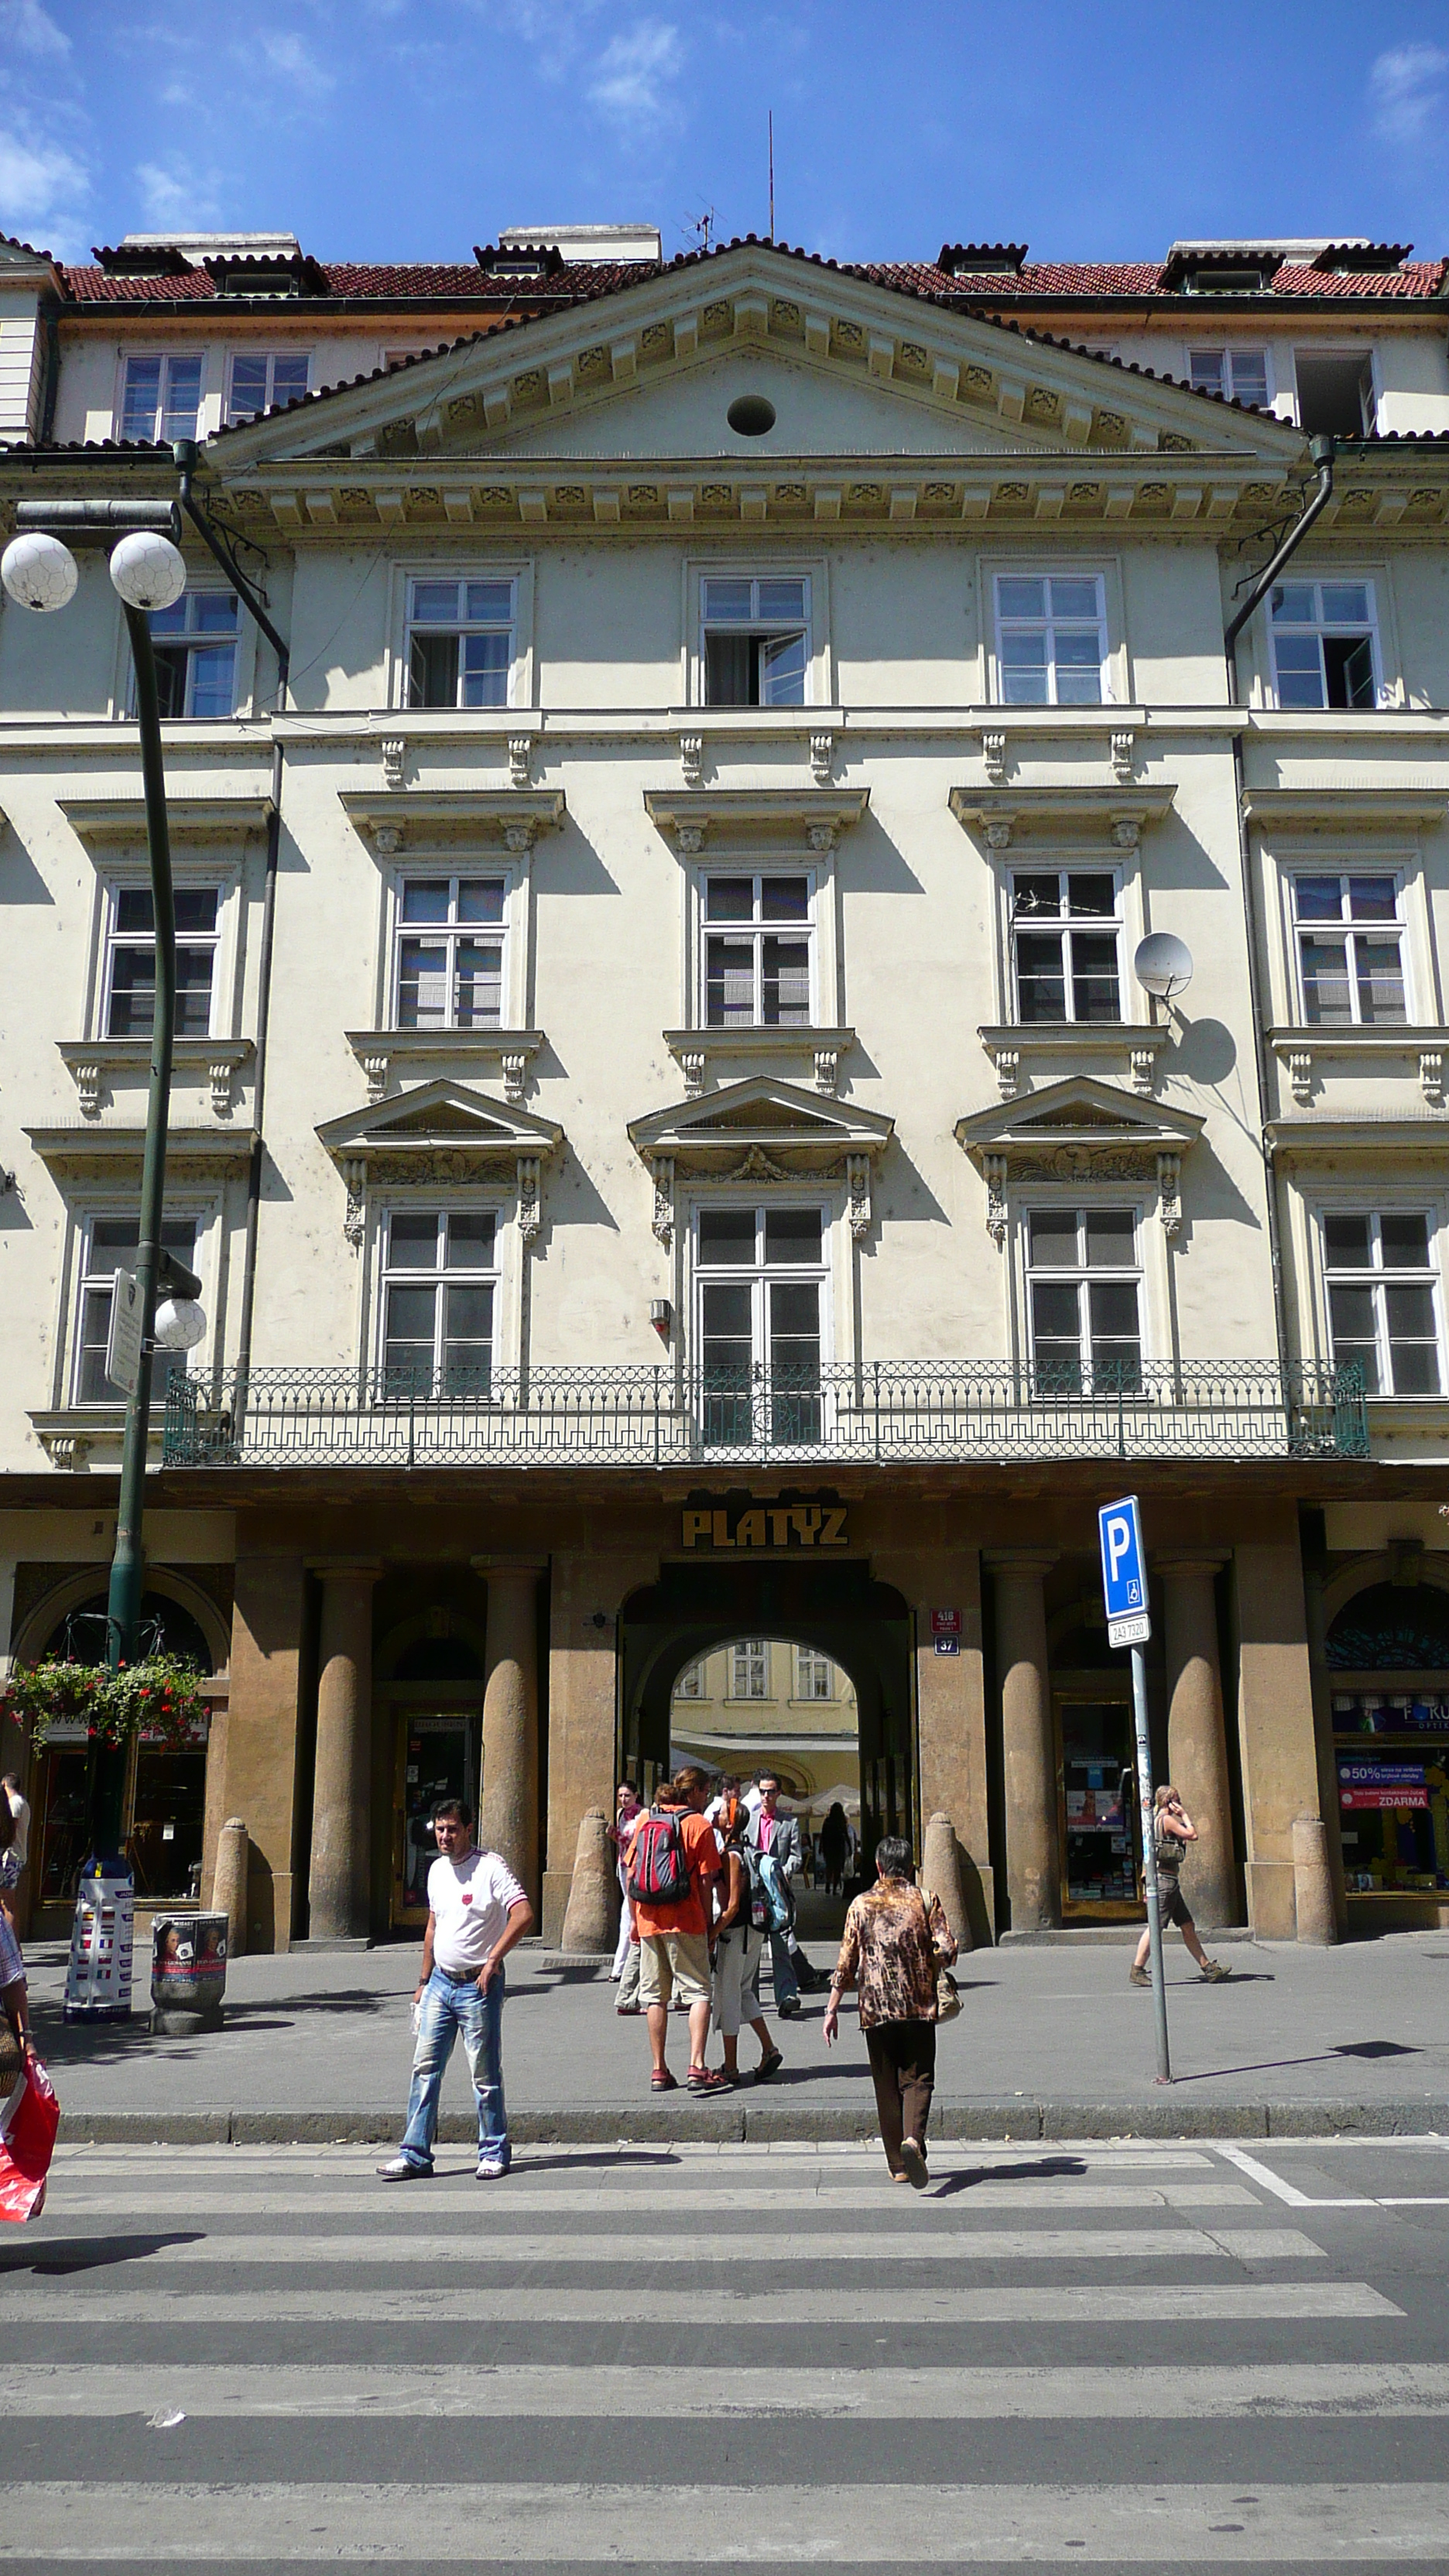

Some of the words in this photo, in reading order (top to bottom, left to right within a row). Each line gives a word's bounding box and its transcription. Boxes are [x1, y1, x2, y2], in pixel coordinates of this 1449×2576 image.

[1107, 1517, 1130, 1582] P
[937, 1611, 954, 1621] 416
[1113, 1625, 1126, 1640] 2A3
[1127, 1622, 1144, 1639] 7320
[940, 1640, 953, 1651] 37
[1351, 1768, 1381, 1780] 50%
[1379, 1797, 1425, 1806] ZDARMA
